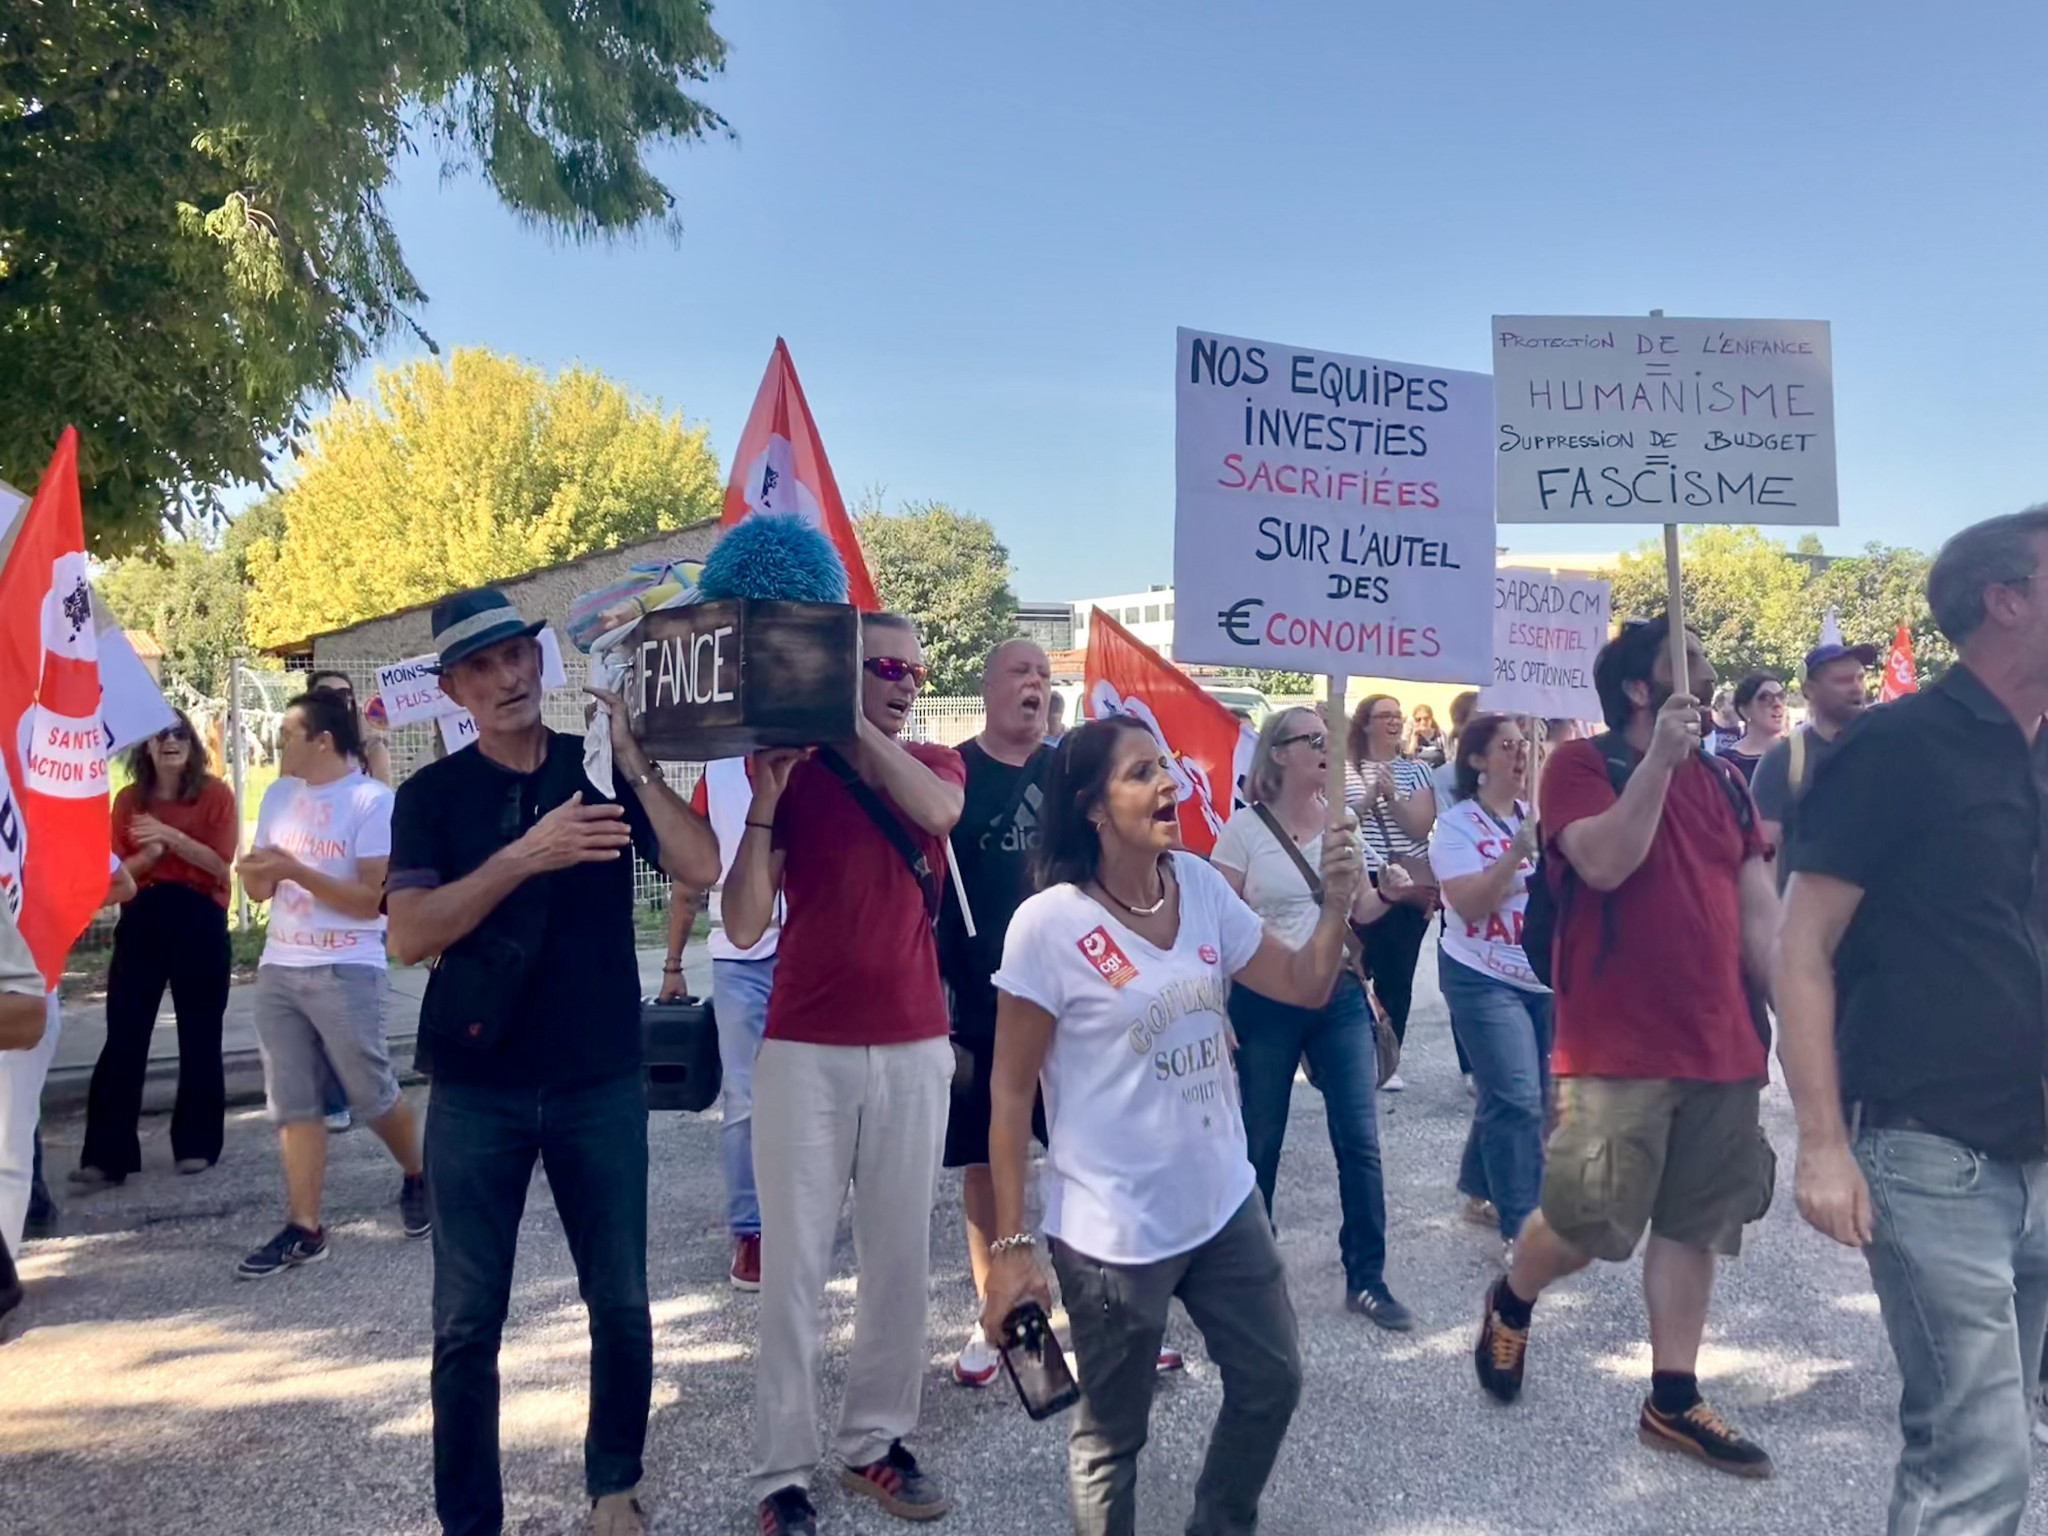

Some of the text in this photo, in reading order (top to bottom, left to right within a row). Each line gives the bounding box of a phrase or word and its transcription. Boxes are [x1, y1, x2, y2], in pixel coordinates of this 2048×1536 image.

[1637, 333, 1680, 355] DE
[1702, 332, 1813, 356] L'ENFANCE
[1191, 338, 1269, 387] NOS
[1649, 430, 1679, 449] DE
[1704, 430, 1818, 452] BUDGET
[1255, 516, 1461, 569] SUR L'AUTEL
[1326, 573, 1389, 604] DES
[395, 689, 432, 711] PLUS
[1099, 951, 1123, 973] cgt
